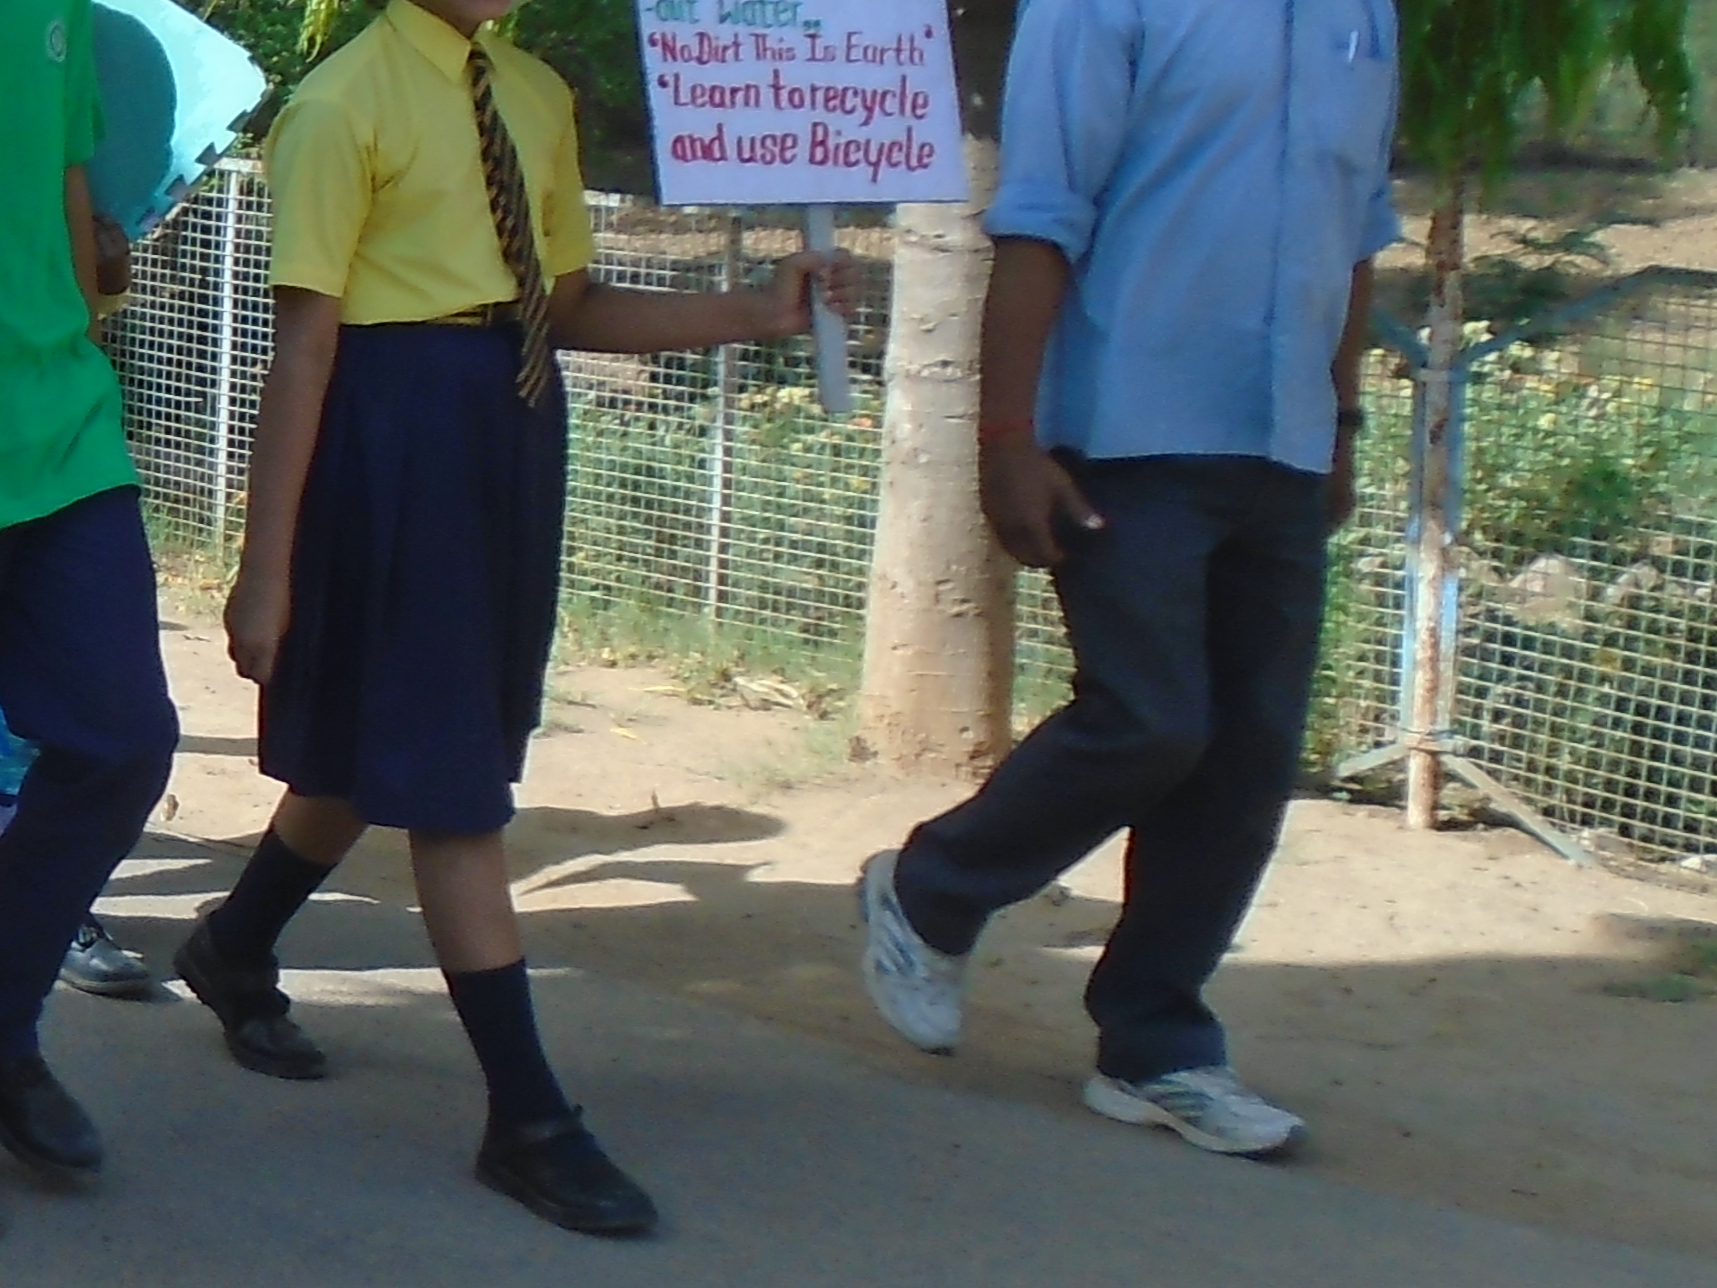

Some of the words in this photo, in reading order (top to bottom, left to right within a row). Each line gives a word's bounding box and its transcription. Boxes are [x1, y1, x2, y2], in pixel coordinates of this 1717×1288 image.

[690, 31, 743, 65] Dirt
[749, 33, 796, 63] This
[804, 33, 836, 62] Is
[768, 68, 805, 110] to
[811, 75, 930, 127] recycle
[671, 122, 727, 163] and
[736, 132, 798, 165] use
[809, 121, 935, 184] Bicycle
